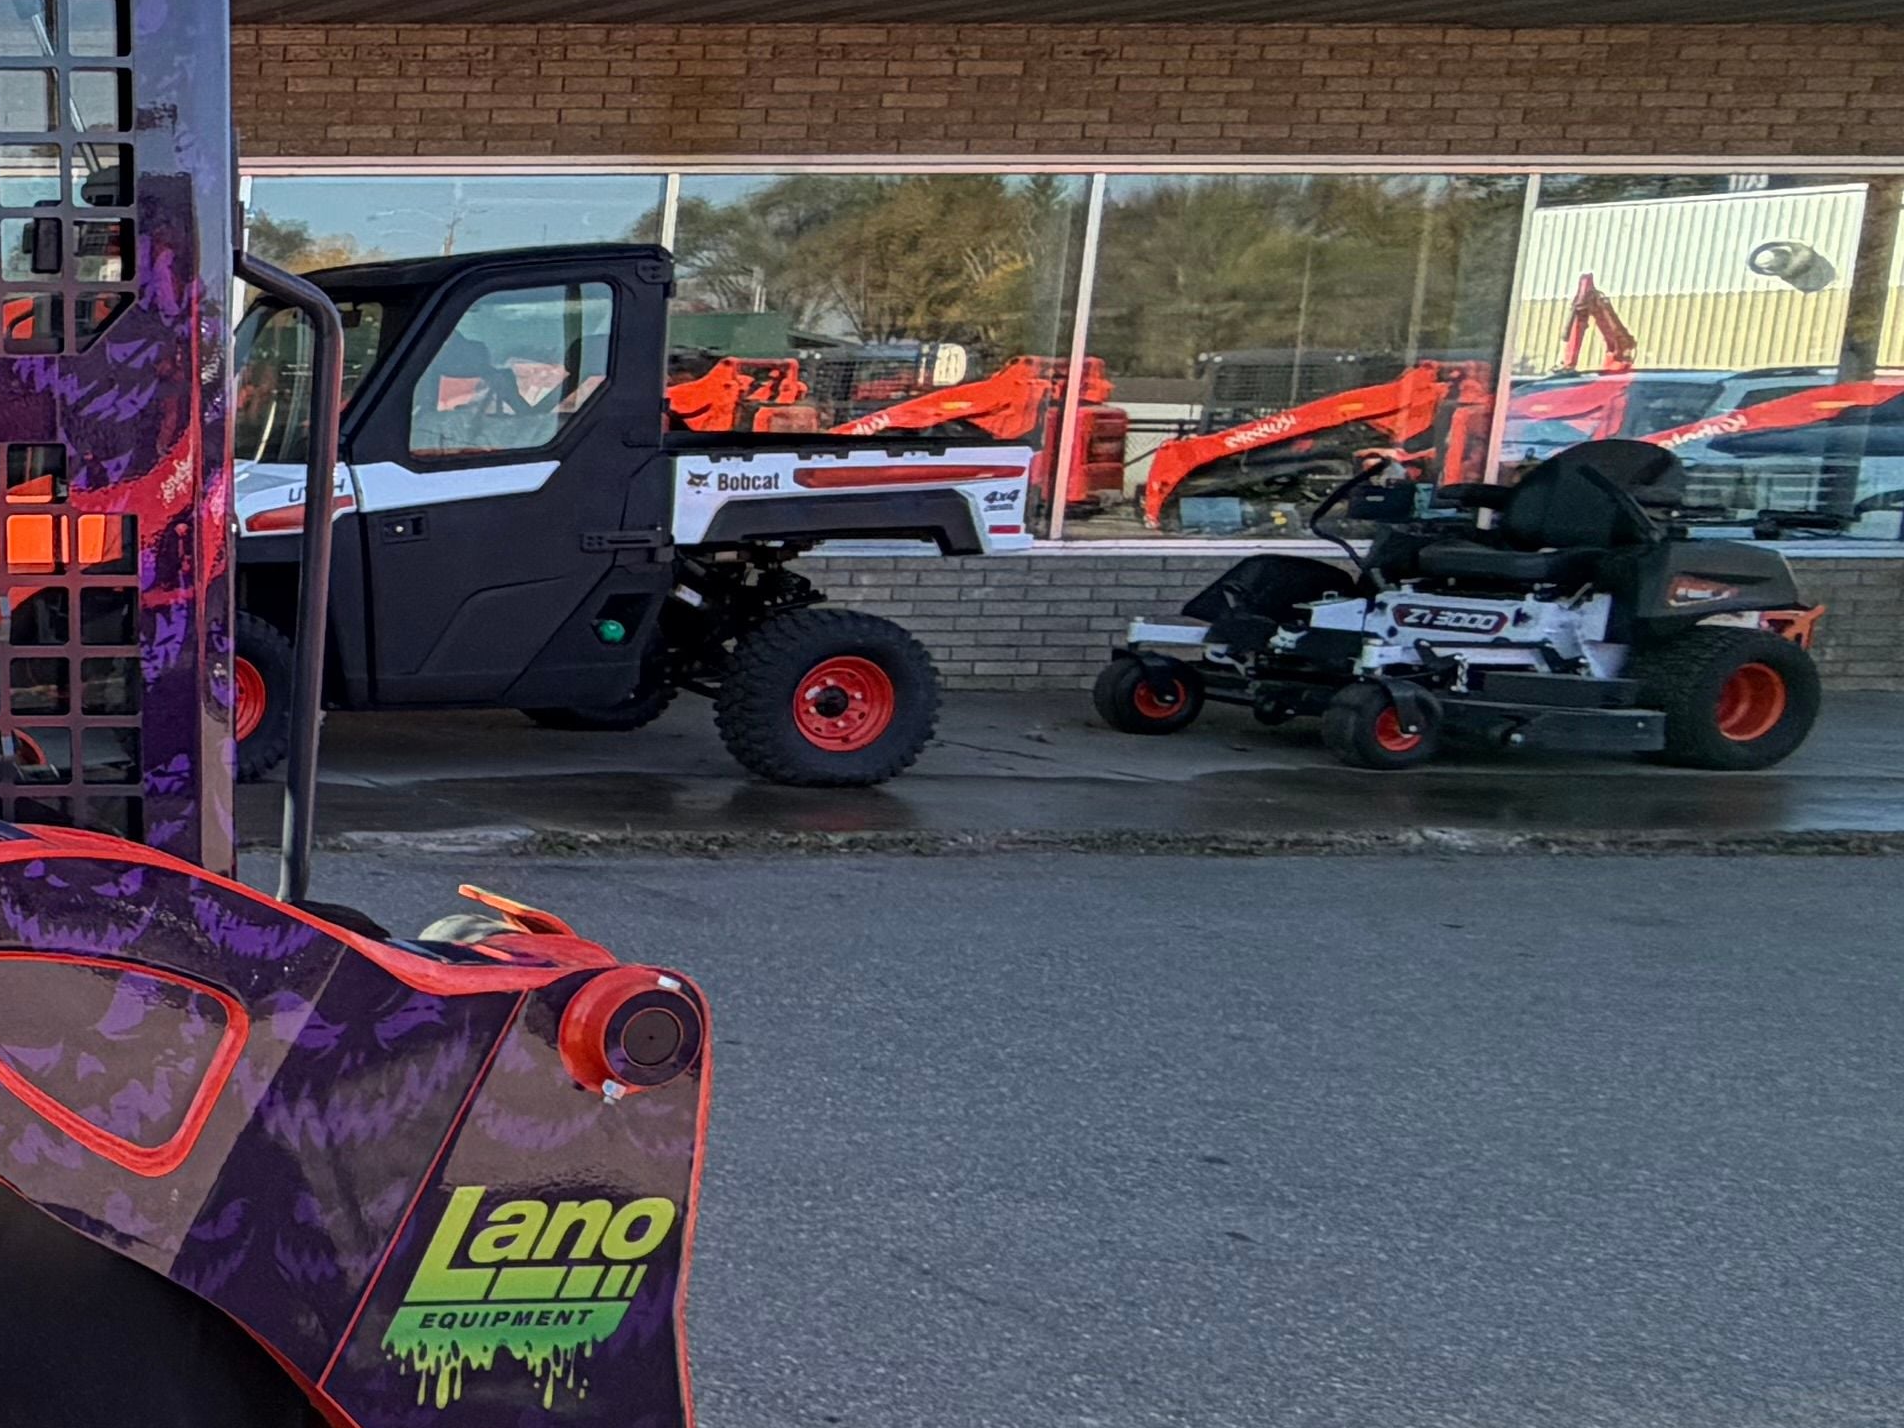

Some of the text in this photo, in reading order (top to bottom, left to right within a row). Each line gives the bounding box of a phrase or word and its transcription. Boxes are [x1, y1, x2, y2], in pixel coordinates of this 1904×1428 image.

[717, 472, 780, 491] Bobcat
[403, 1185, 677, 1302] Lano
[418, 1308, 595, 1330] EQUIPMENT
